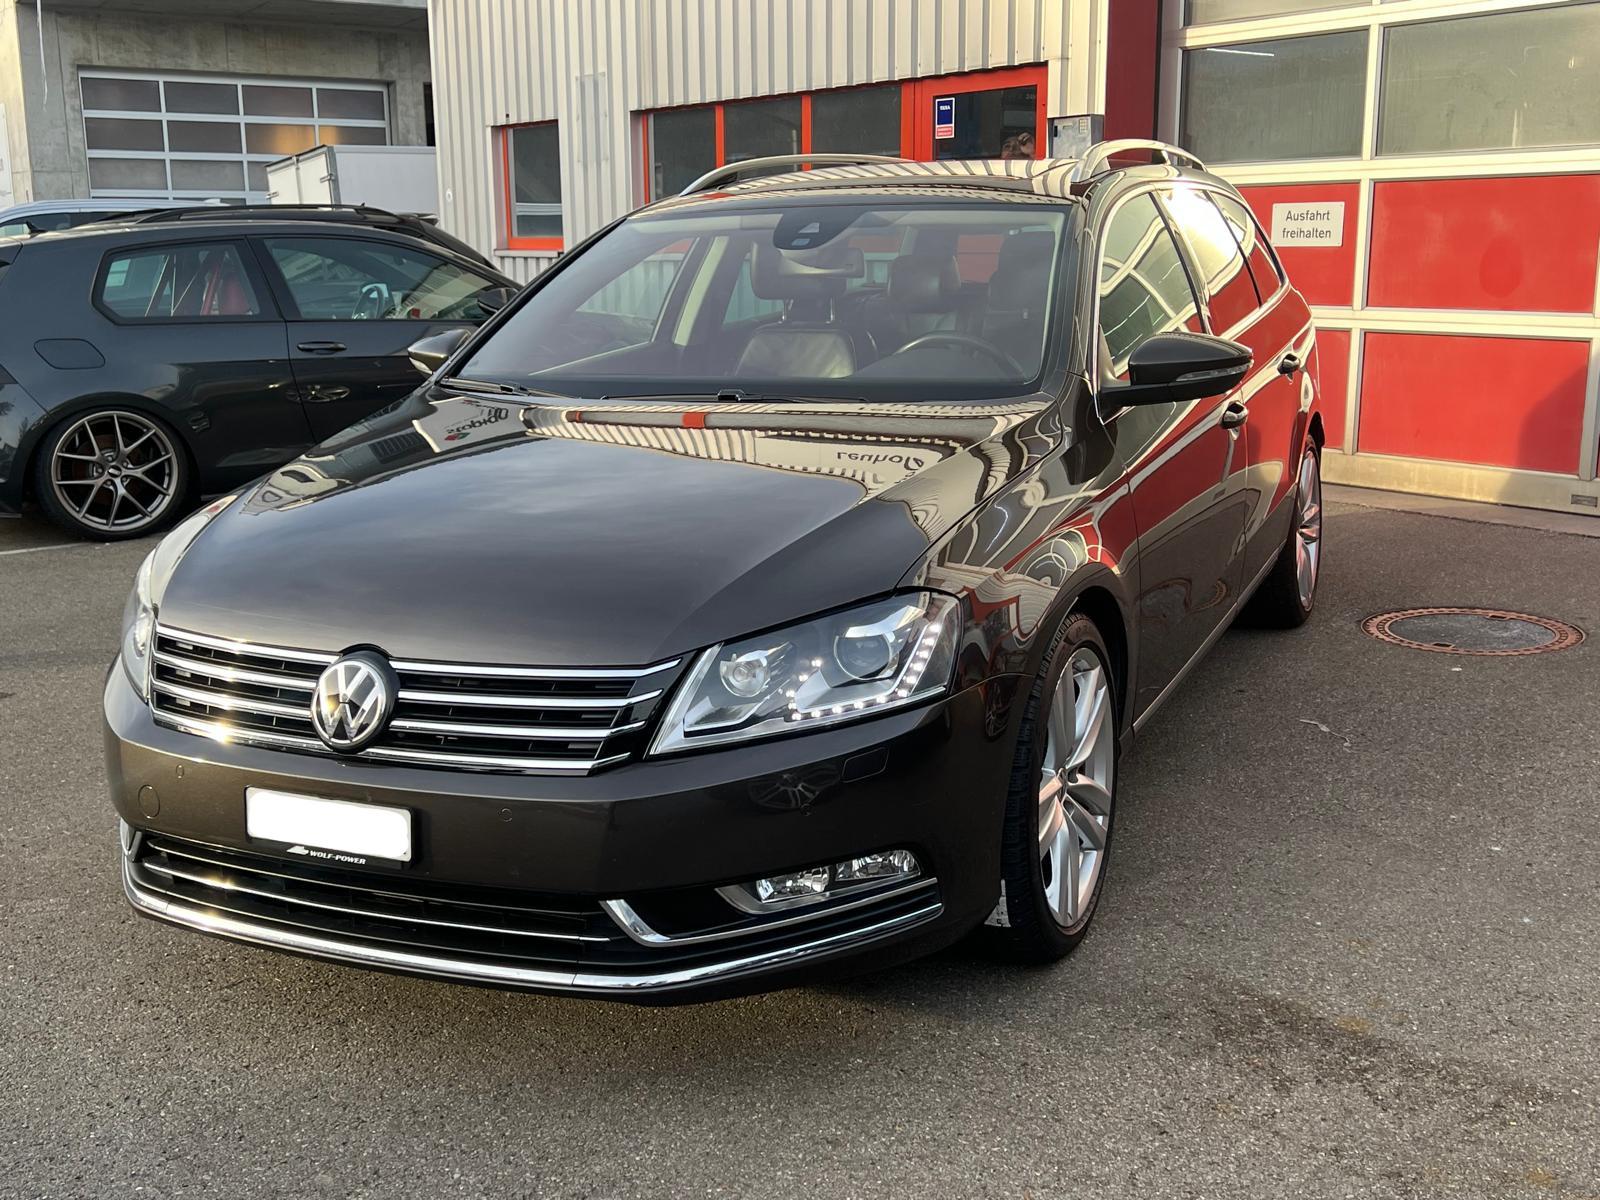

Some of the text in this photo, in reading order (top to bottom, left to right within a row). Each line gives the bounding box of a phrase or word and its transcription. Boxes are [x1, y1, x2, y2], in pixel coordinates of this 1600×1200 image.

[1286, 210, 1330, 221] Ausfahrt
[1283, 227, 1331, 239] freihalten
[312, 660, 386, 744] VW
[310, 850, 366, 864] WOLF-POWER
